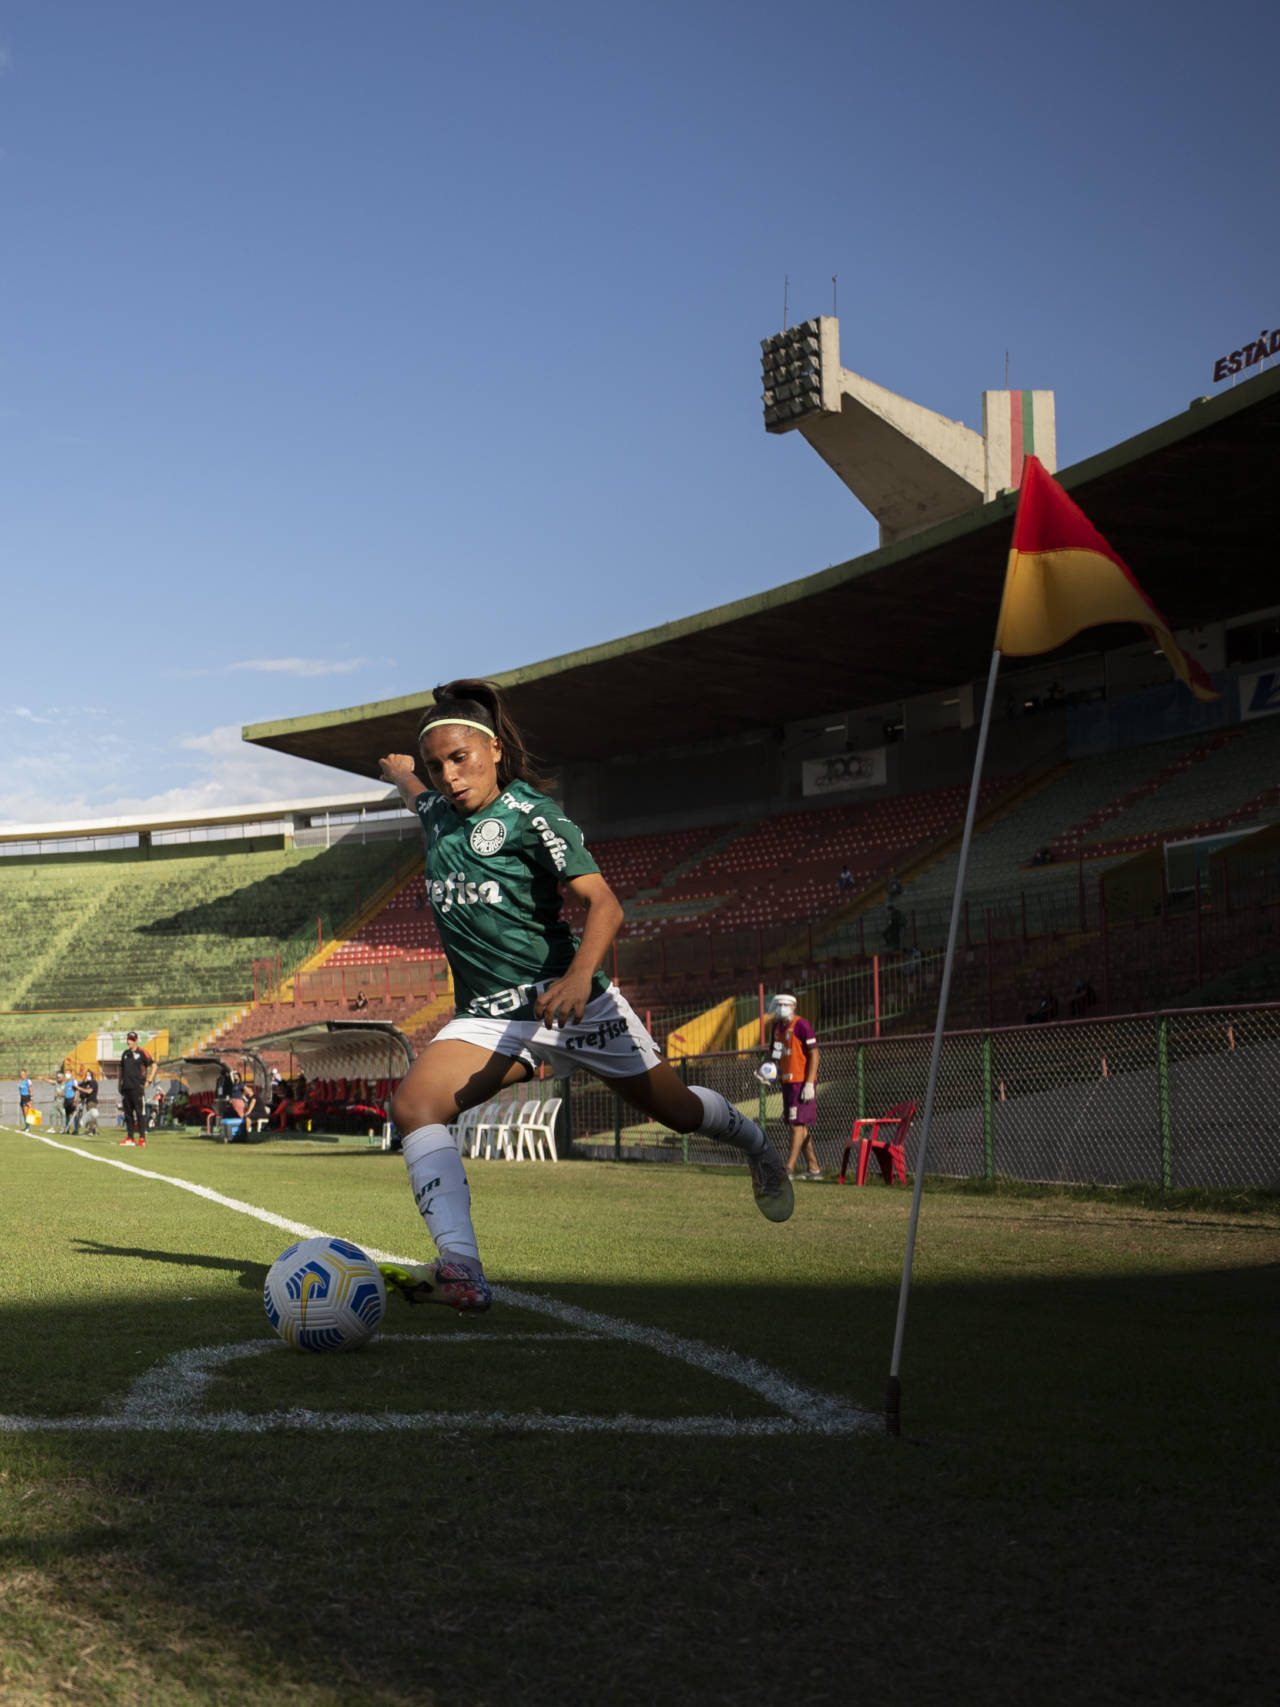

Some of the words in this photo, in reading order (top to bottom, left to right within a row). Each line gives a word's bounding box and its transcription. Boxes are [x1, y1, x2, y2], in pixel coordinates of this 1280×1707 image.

[532, 816, 567, 872] crefisa
[426, 871, 503, 913] refisa
[566, 1018, 629, 1050] crefisa
